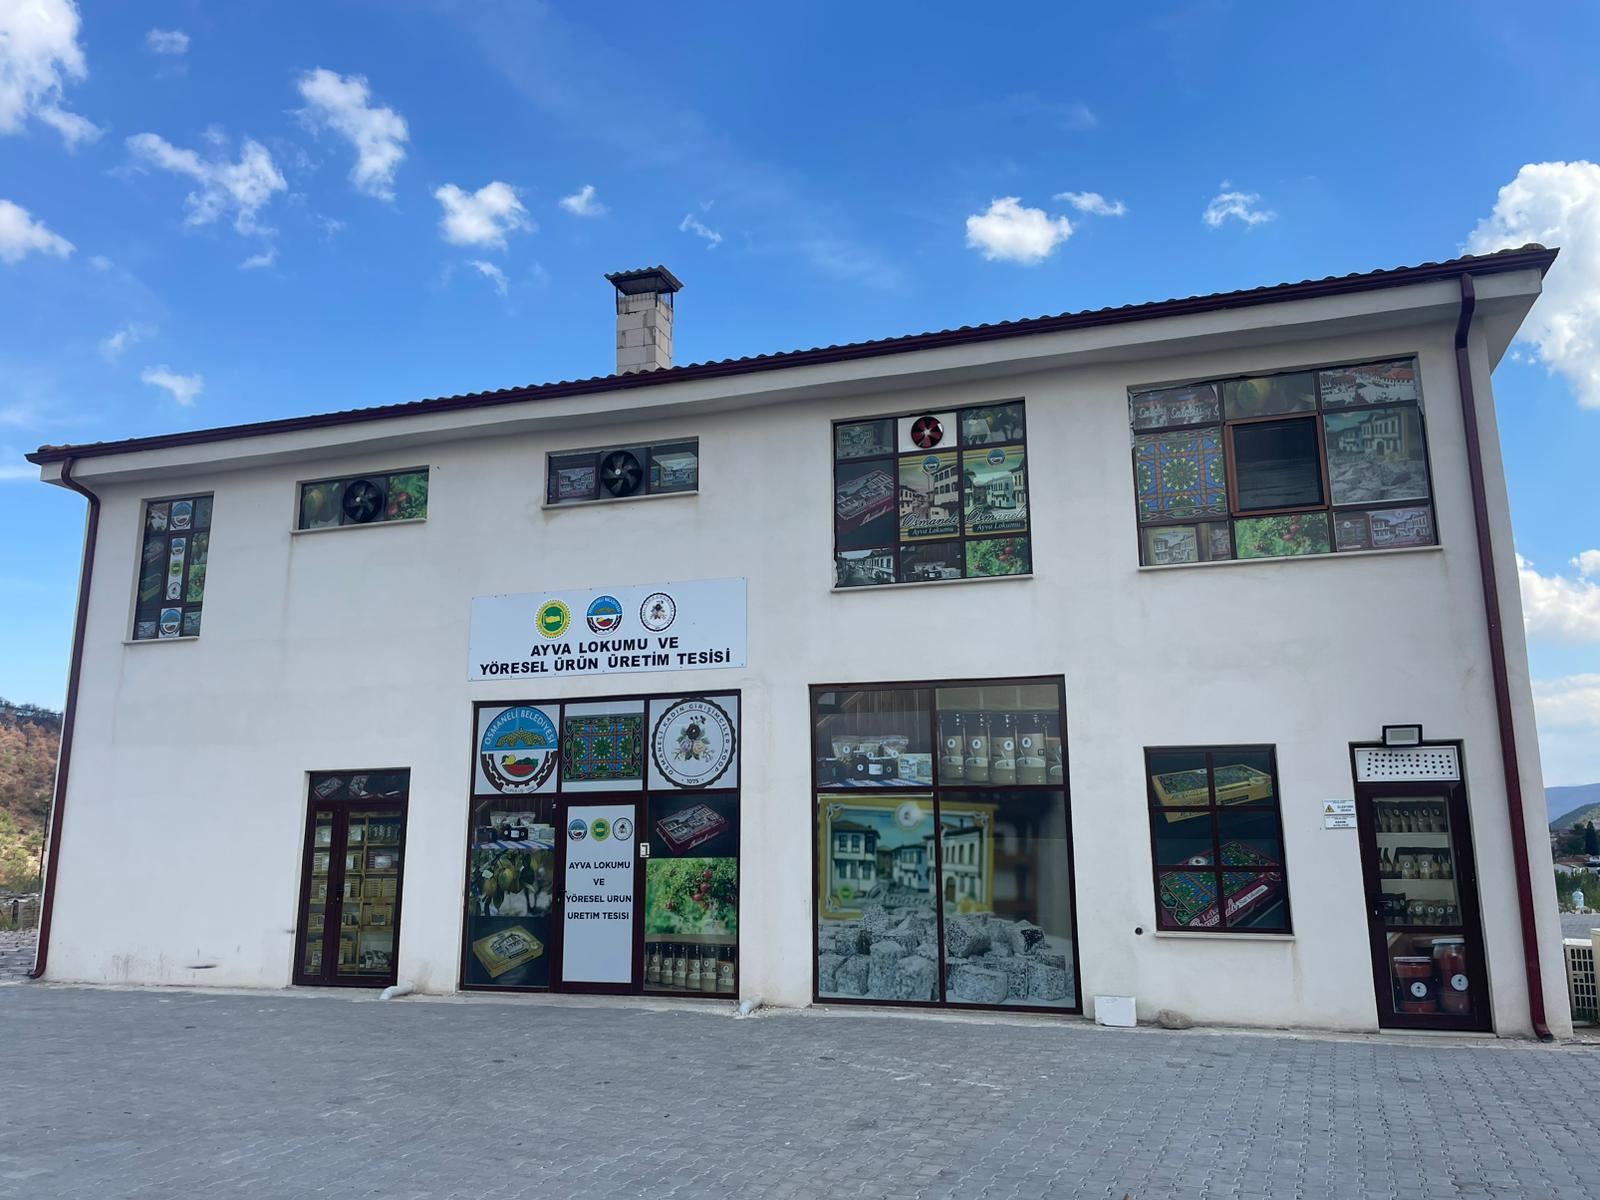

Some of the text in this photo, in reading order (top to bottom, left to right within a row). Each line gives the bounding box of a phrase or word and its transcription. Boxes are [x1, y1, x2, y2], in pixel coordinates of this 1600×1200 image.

[531, 636, 679, 656] AYVA LOKUMU VE
[480, 647, 731, 676] YÖRESEL ÜRÜN ÜRETİM TESİSİ
[568, 861, 631, 870] AYVA LOKUMU
[593, 878, 605, 886] VE
[566, 893, 605, 903] YÖRESEL
